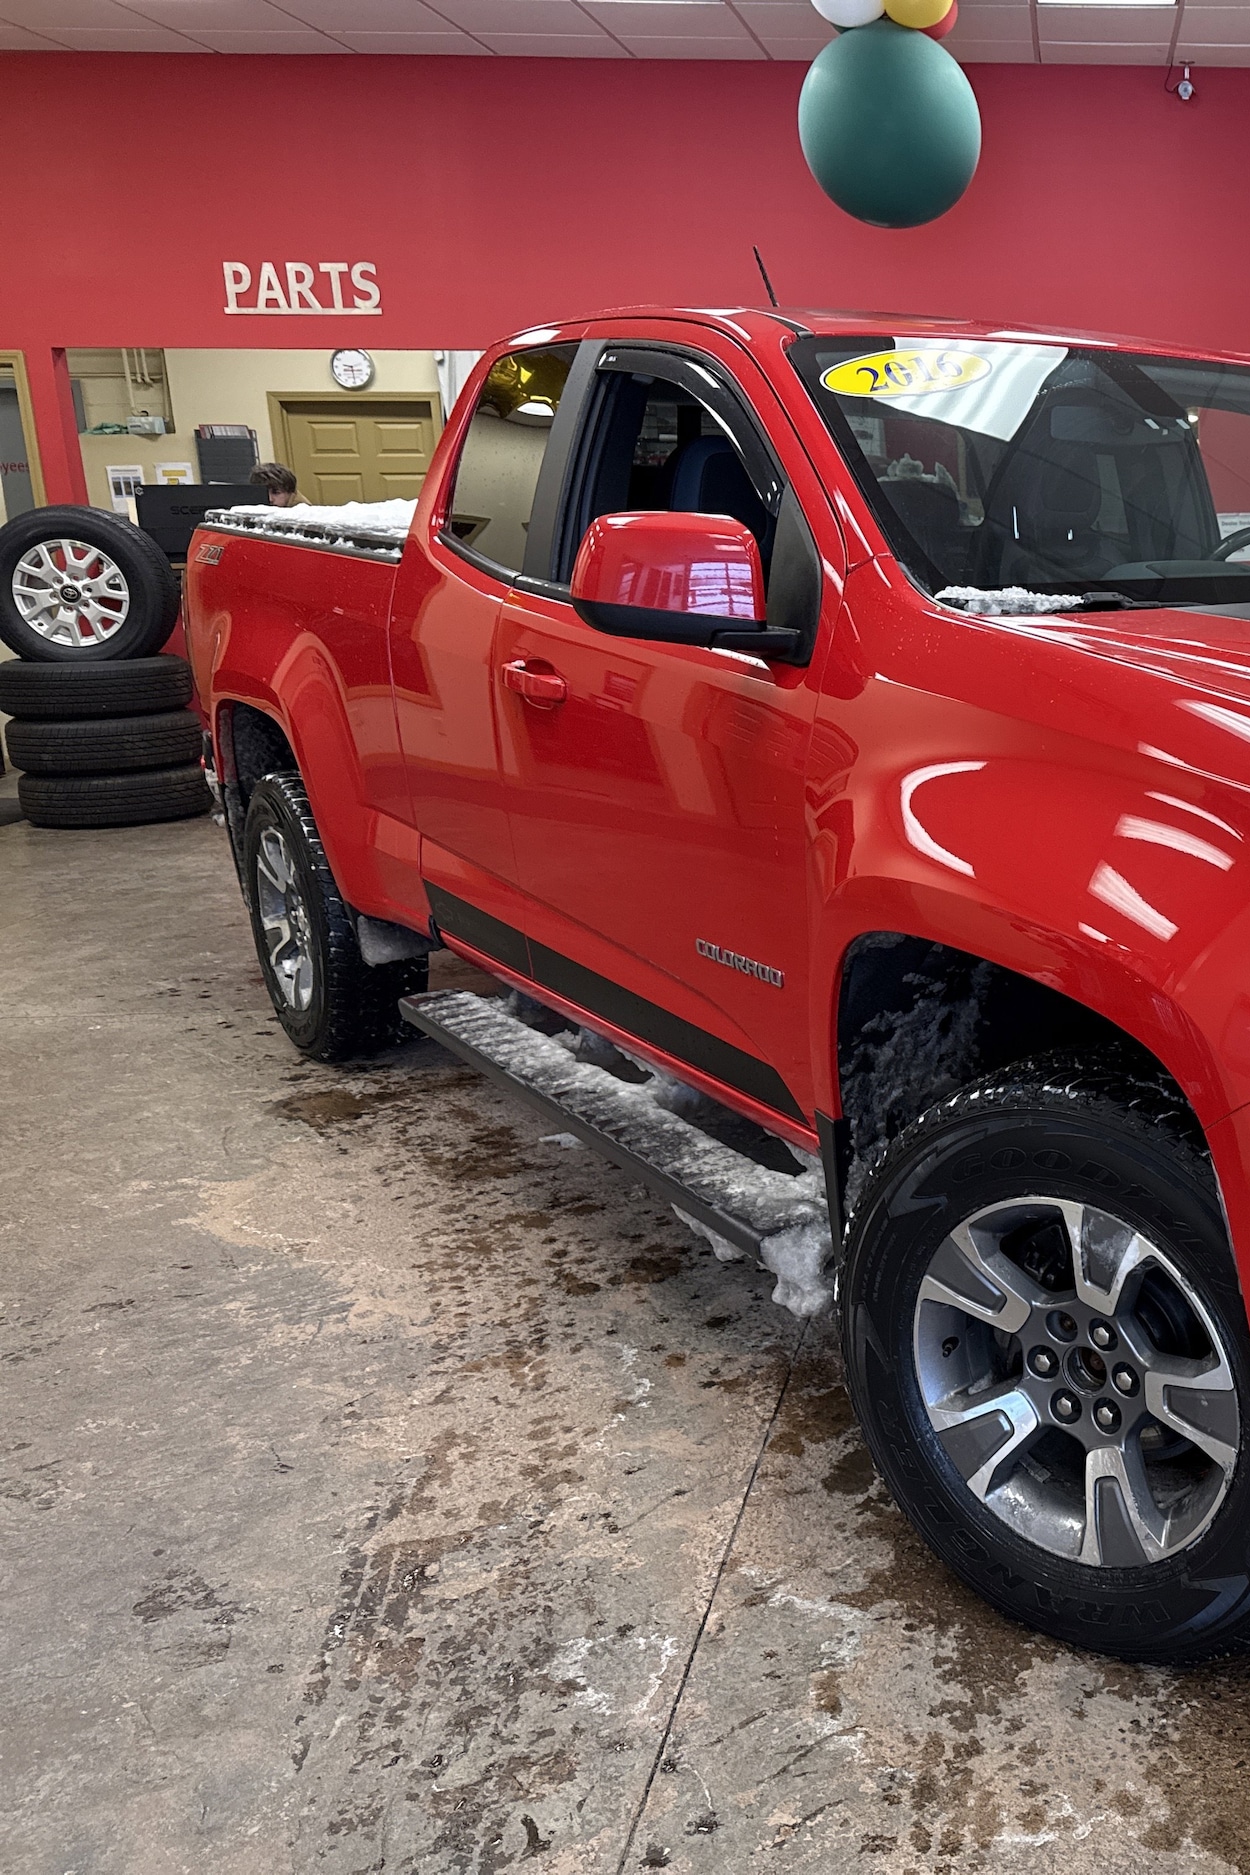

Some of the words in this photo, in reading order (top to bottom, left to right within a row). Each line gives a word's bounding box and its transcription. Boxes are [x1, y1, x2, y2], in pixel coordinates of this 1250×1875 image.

[222, 261, 382, 313] PARTS
[856, 351, 963, 392] 2016
[0, 462, 29, 476] yees
[194, 543, 225, 566] Z71
[695, 937, 785, 989] COLORADO
